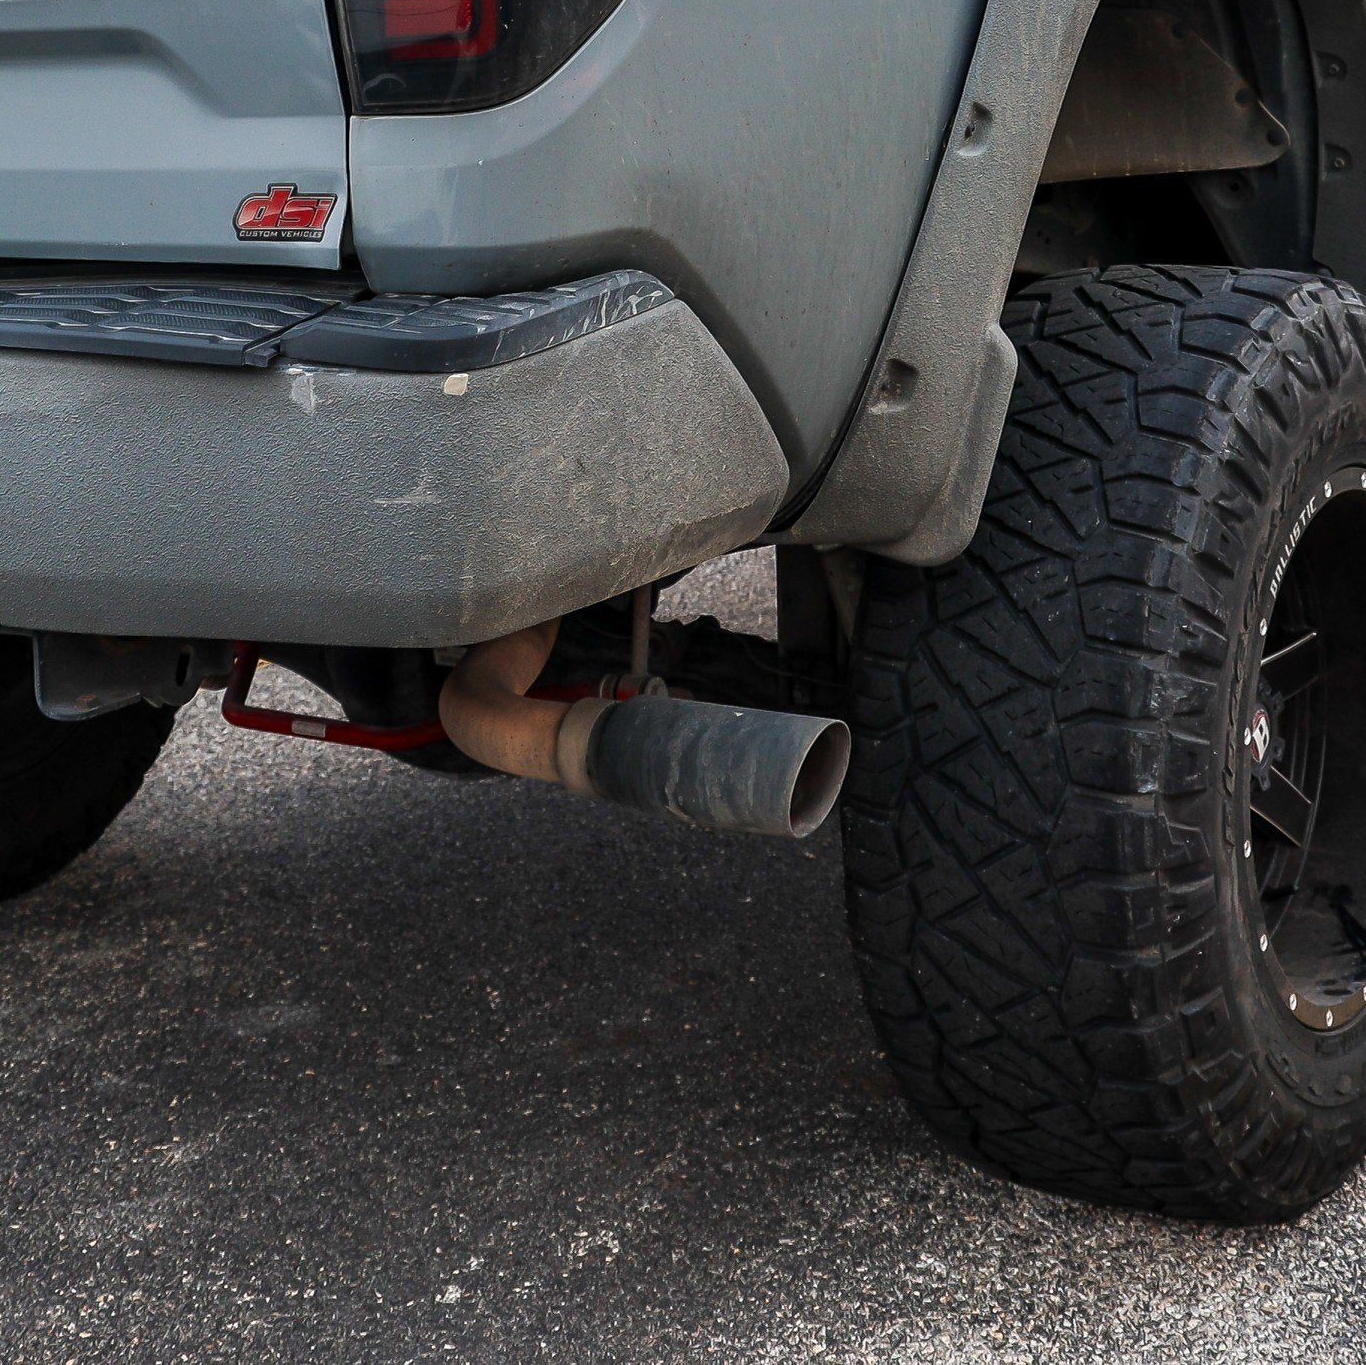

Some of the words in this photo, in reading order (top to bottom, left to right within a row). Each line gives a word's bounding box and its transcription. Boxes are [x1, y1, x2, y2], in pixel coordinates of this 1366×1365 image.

[239, 230, 278, 238] CUSTOM
[281, 230, 323, 239] VEHICLES
[1270, 496, 1317, 599] BALLISTIC
